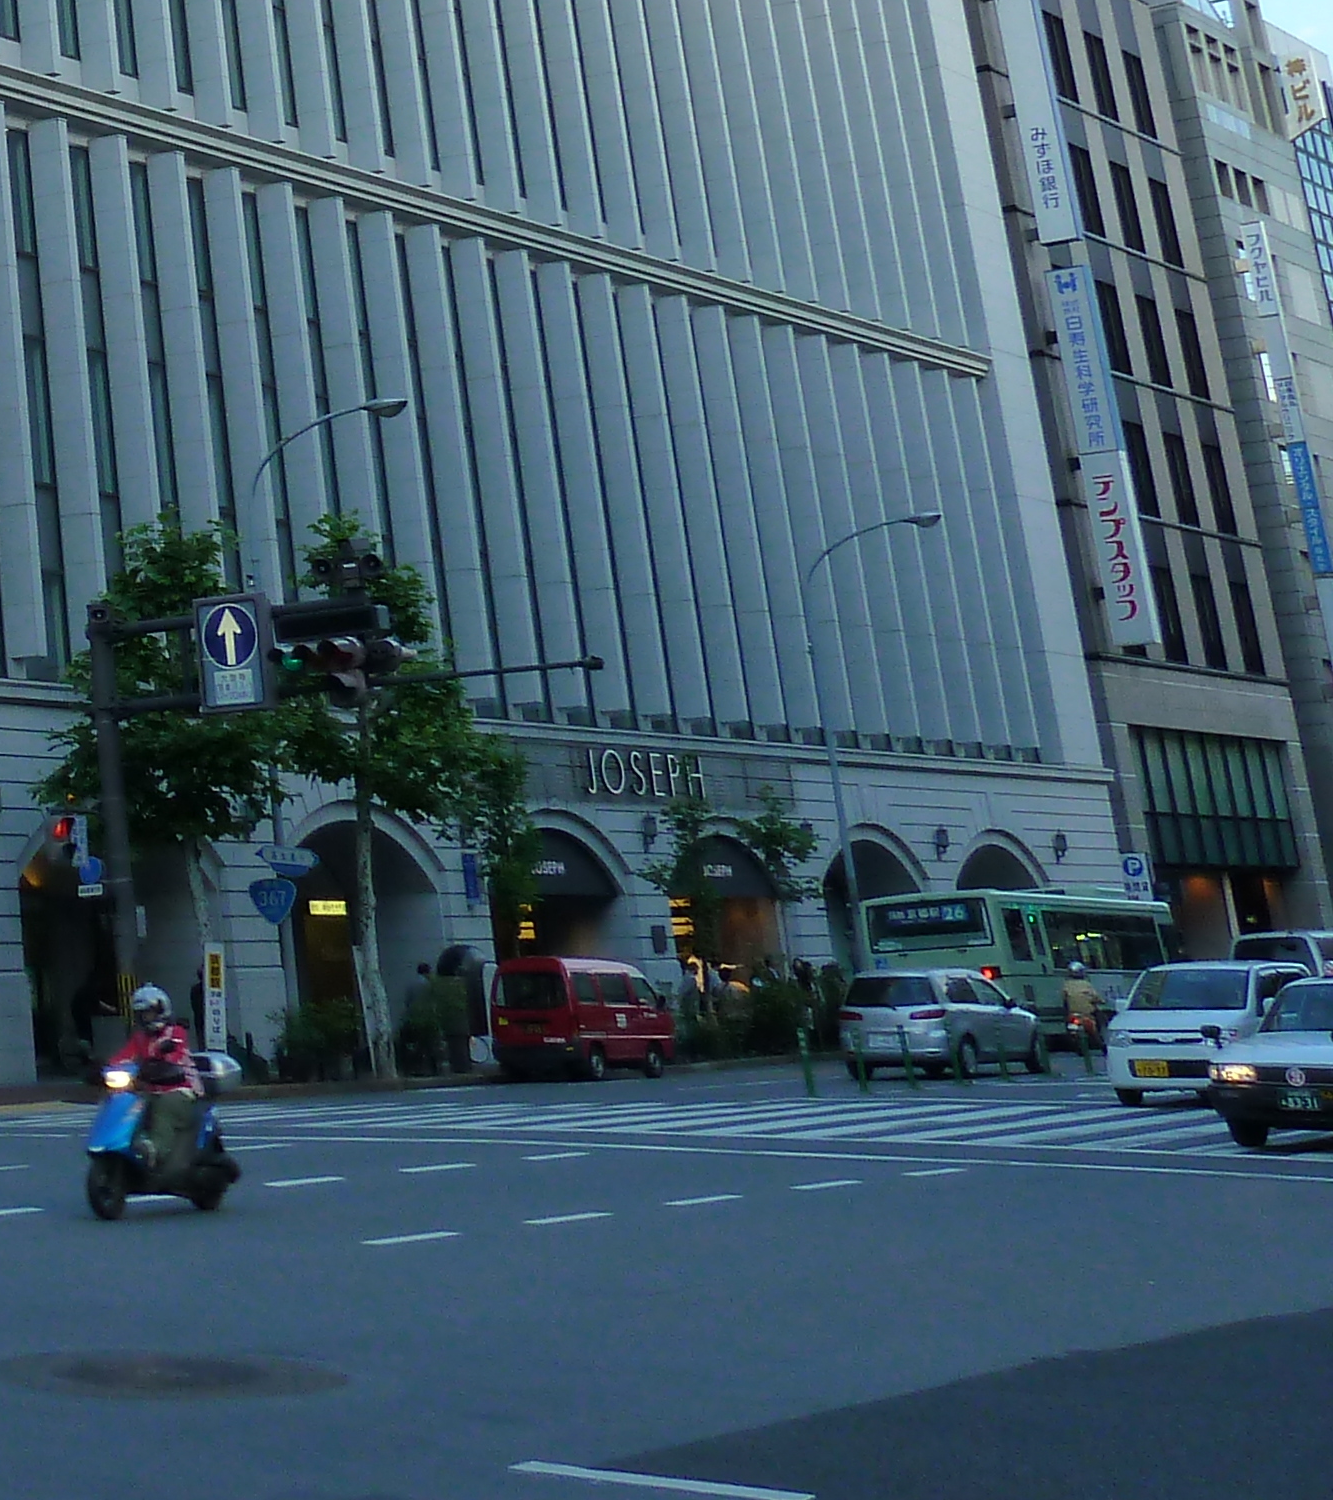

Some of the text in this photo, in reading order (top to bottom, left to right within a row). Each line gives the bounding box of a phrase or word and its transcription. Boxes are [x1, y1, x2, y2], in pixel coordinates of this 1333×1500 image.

[1030, 127, 1060, 209] みずほ銀行
[1092, 474, 1137, 621] テンプスタッフ
[588, 749, 706, 799] JOSEPH
[258, 890, 287, 907] 367
[943, 904, 965, 921] 26
